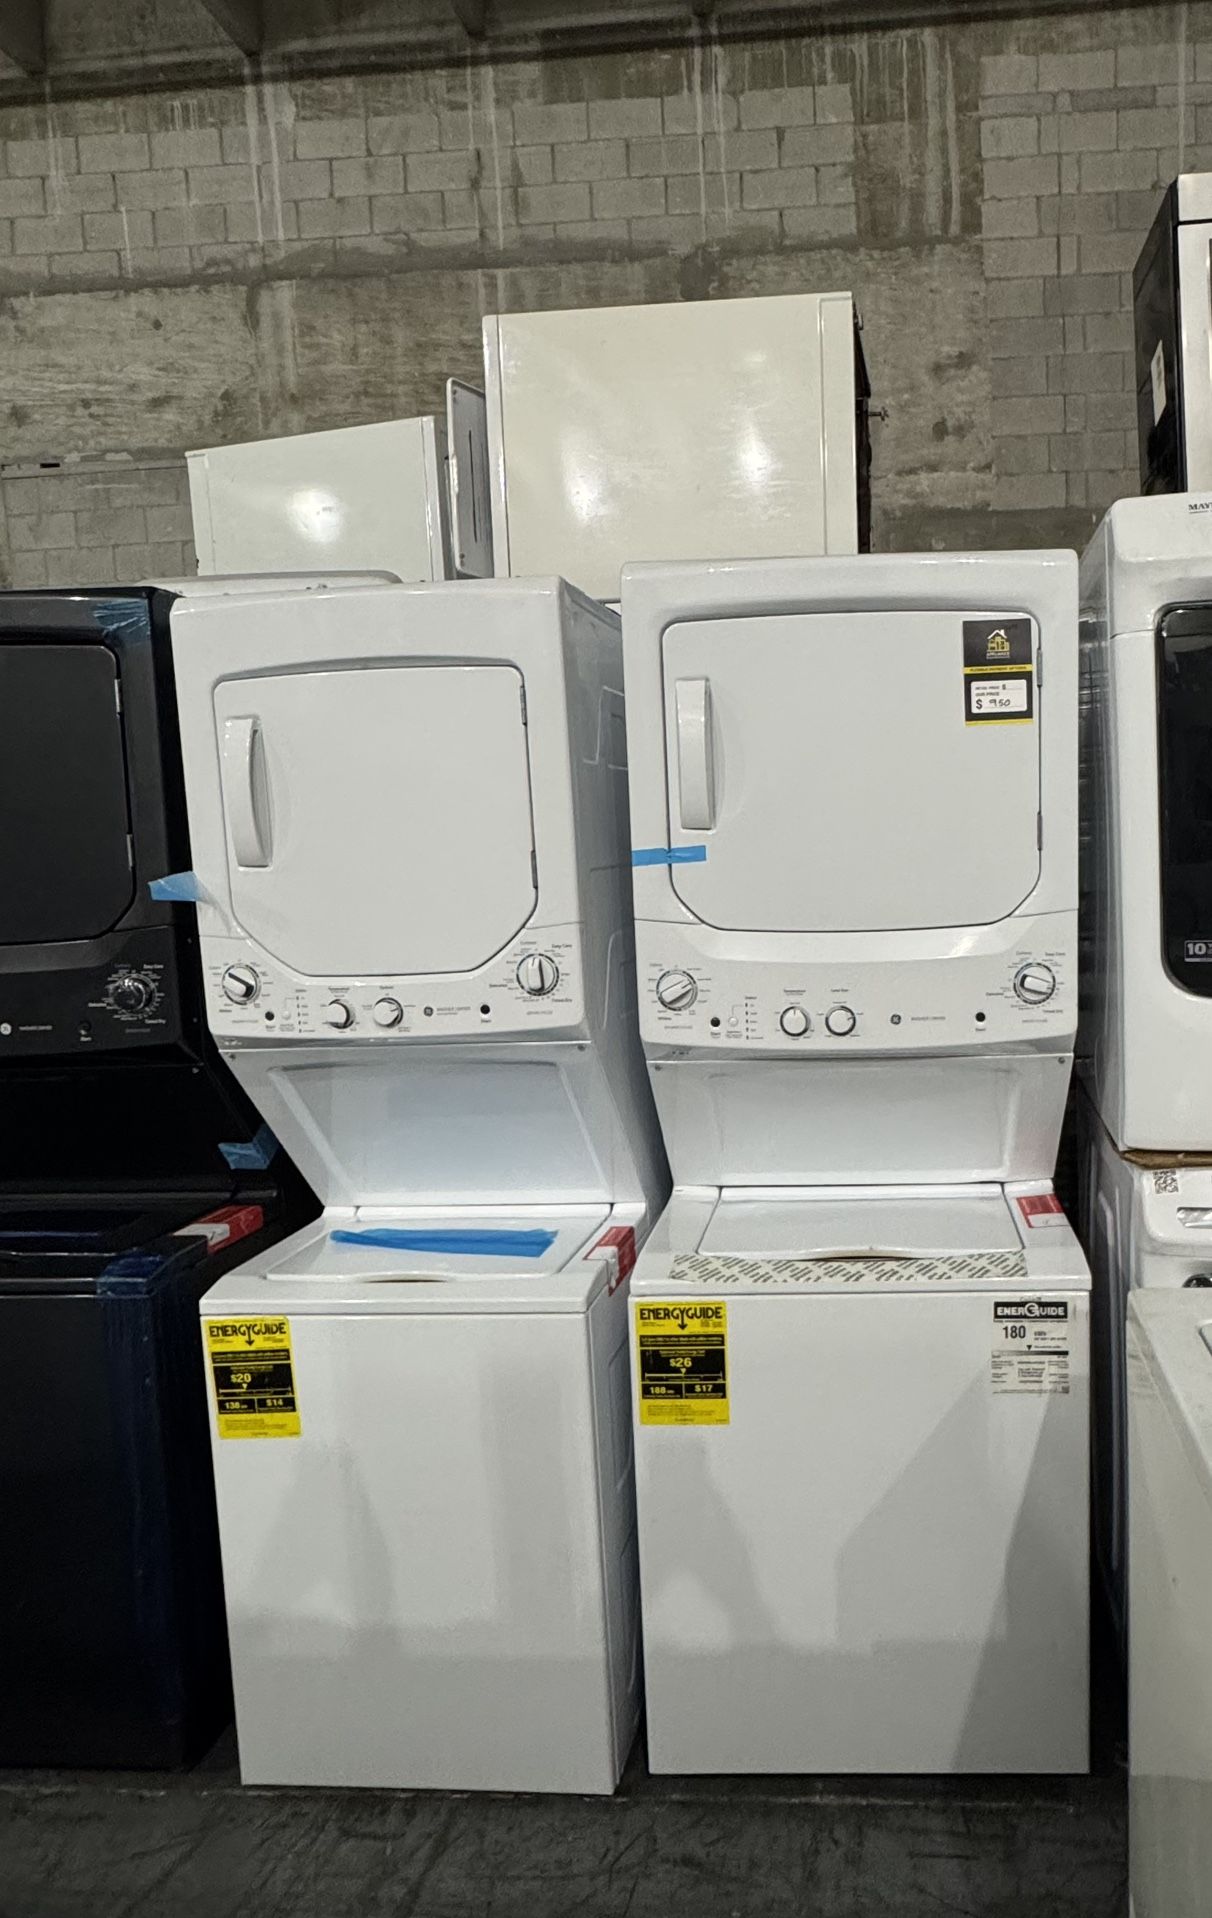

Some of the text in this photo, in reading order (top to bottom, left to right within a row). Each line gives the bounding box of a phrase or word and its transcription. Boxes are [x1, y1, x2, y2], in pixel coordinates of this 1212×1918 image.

[975, 698, 1011, 710] $ 950
[1187, 942, 1206, 955] 10
[640, 1306, 723, 1320] ENERGYGUIDE
[209, 1322, 287, 1337] ENERGYGUIDE
[1002, 1325, 1026, 1339] 180
[669, 1357, 692, 1368] $26
[230, 1373, 252, 1384] $20
[694, 1384, 713, 1392] $17
[266, 1398, 283, 1406] $14
